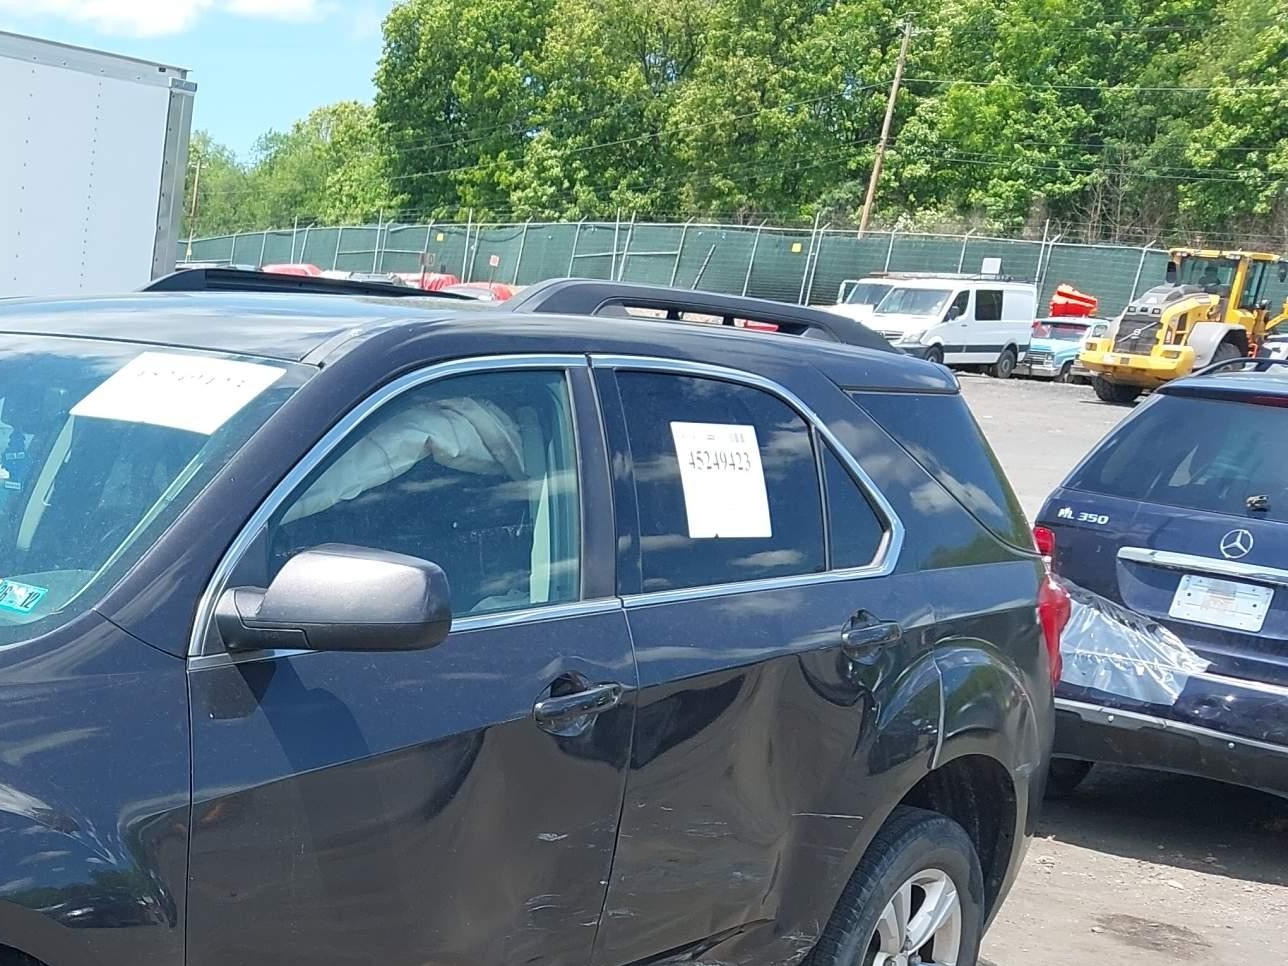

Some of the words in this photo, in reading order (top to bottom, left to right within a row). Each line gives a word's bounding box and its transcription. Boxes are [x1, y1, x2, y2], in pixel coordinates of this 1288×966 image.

[689, 450, 751, 471] 45249423
[1078, 512, 1109, 524] 350
[20, 591, 40, 609] 12
